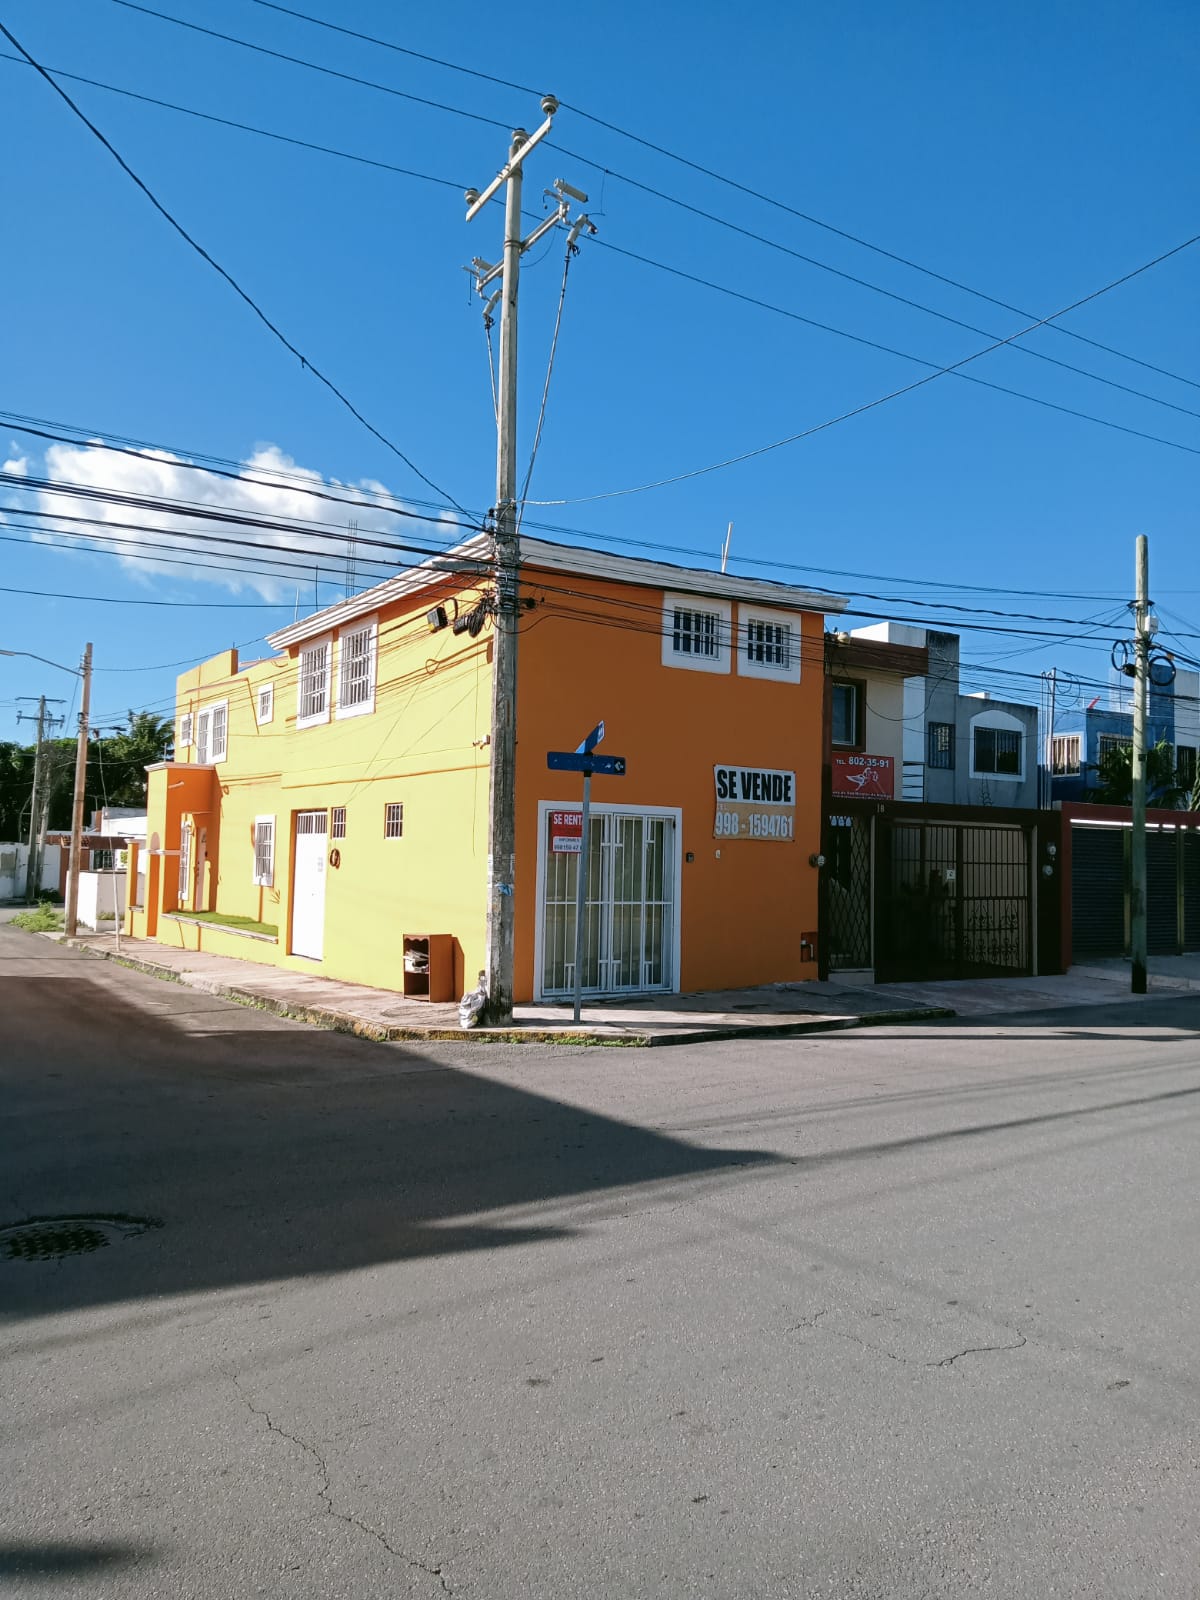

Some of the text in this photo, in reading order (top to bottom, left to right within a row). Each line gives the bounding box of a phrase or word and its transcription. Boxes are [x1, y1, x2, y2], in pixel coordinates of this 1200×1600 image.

[848, 756, 889, 768] 802-35-91
[717, 769, 792, 803] SE VENDE
[553, 813, 583, 826] SE RENT
[715, 811, 739, 836] 998
[748, 813, 793, 838] 1594761
